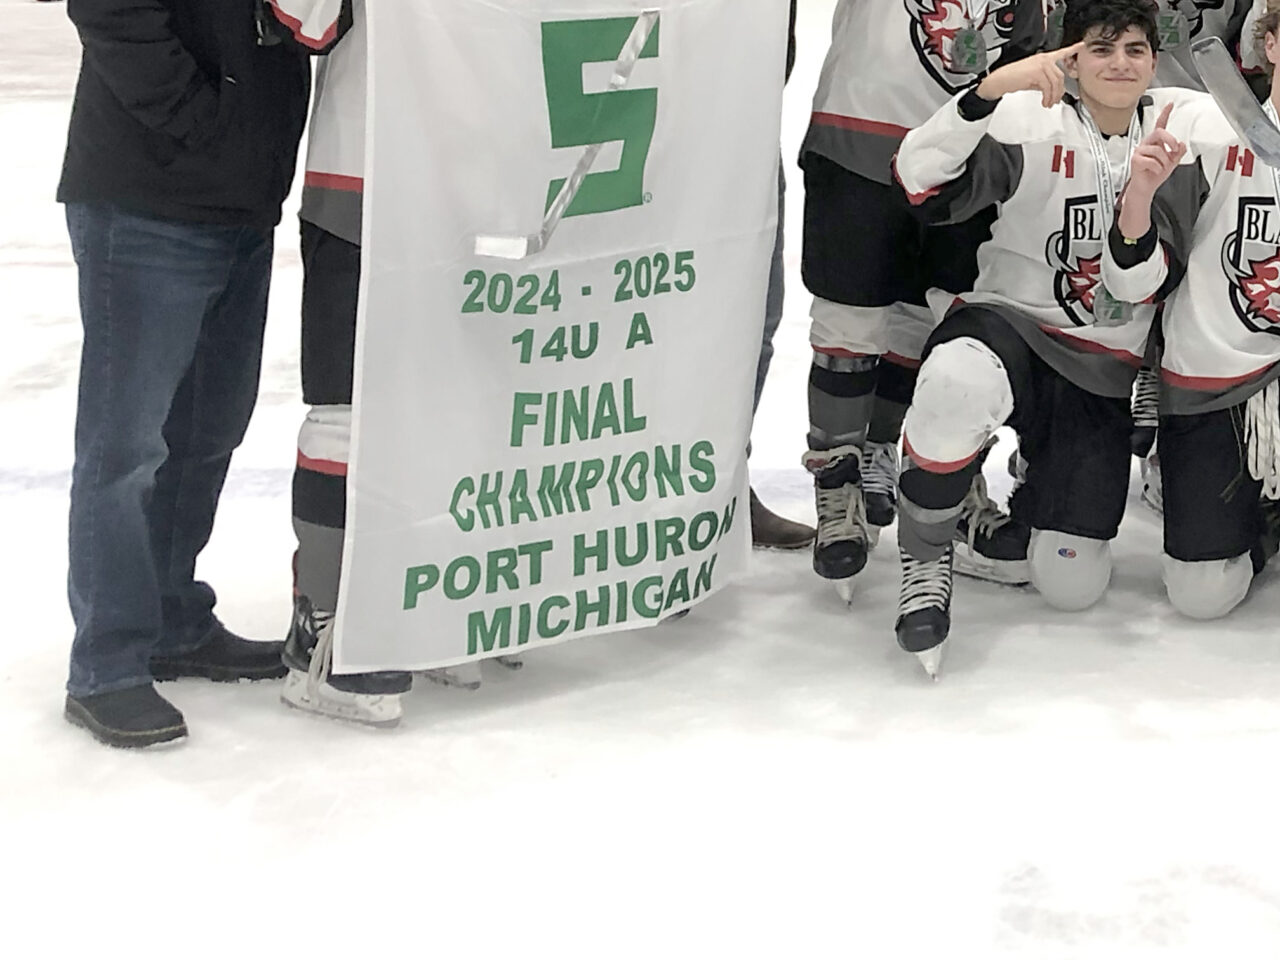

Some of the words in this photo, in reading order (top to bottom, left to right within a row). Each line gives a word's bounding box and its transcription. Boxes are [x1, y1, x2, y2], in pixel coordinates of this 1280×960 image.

[462, 268, 563, 316] 2024
[613, 250, 695, 303] 2025
[511, 322, 599, 365] 14U
[625, 312, 653, 350] A
[510, 378, 648, 447] FINAL
[449, 441, 716, 533] CHAMPIONS
[403, 540, 552, 610] PORT
[574, 495, 737, 579] HURON
[466, 552, 718, 654] MICHIGAN
